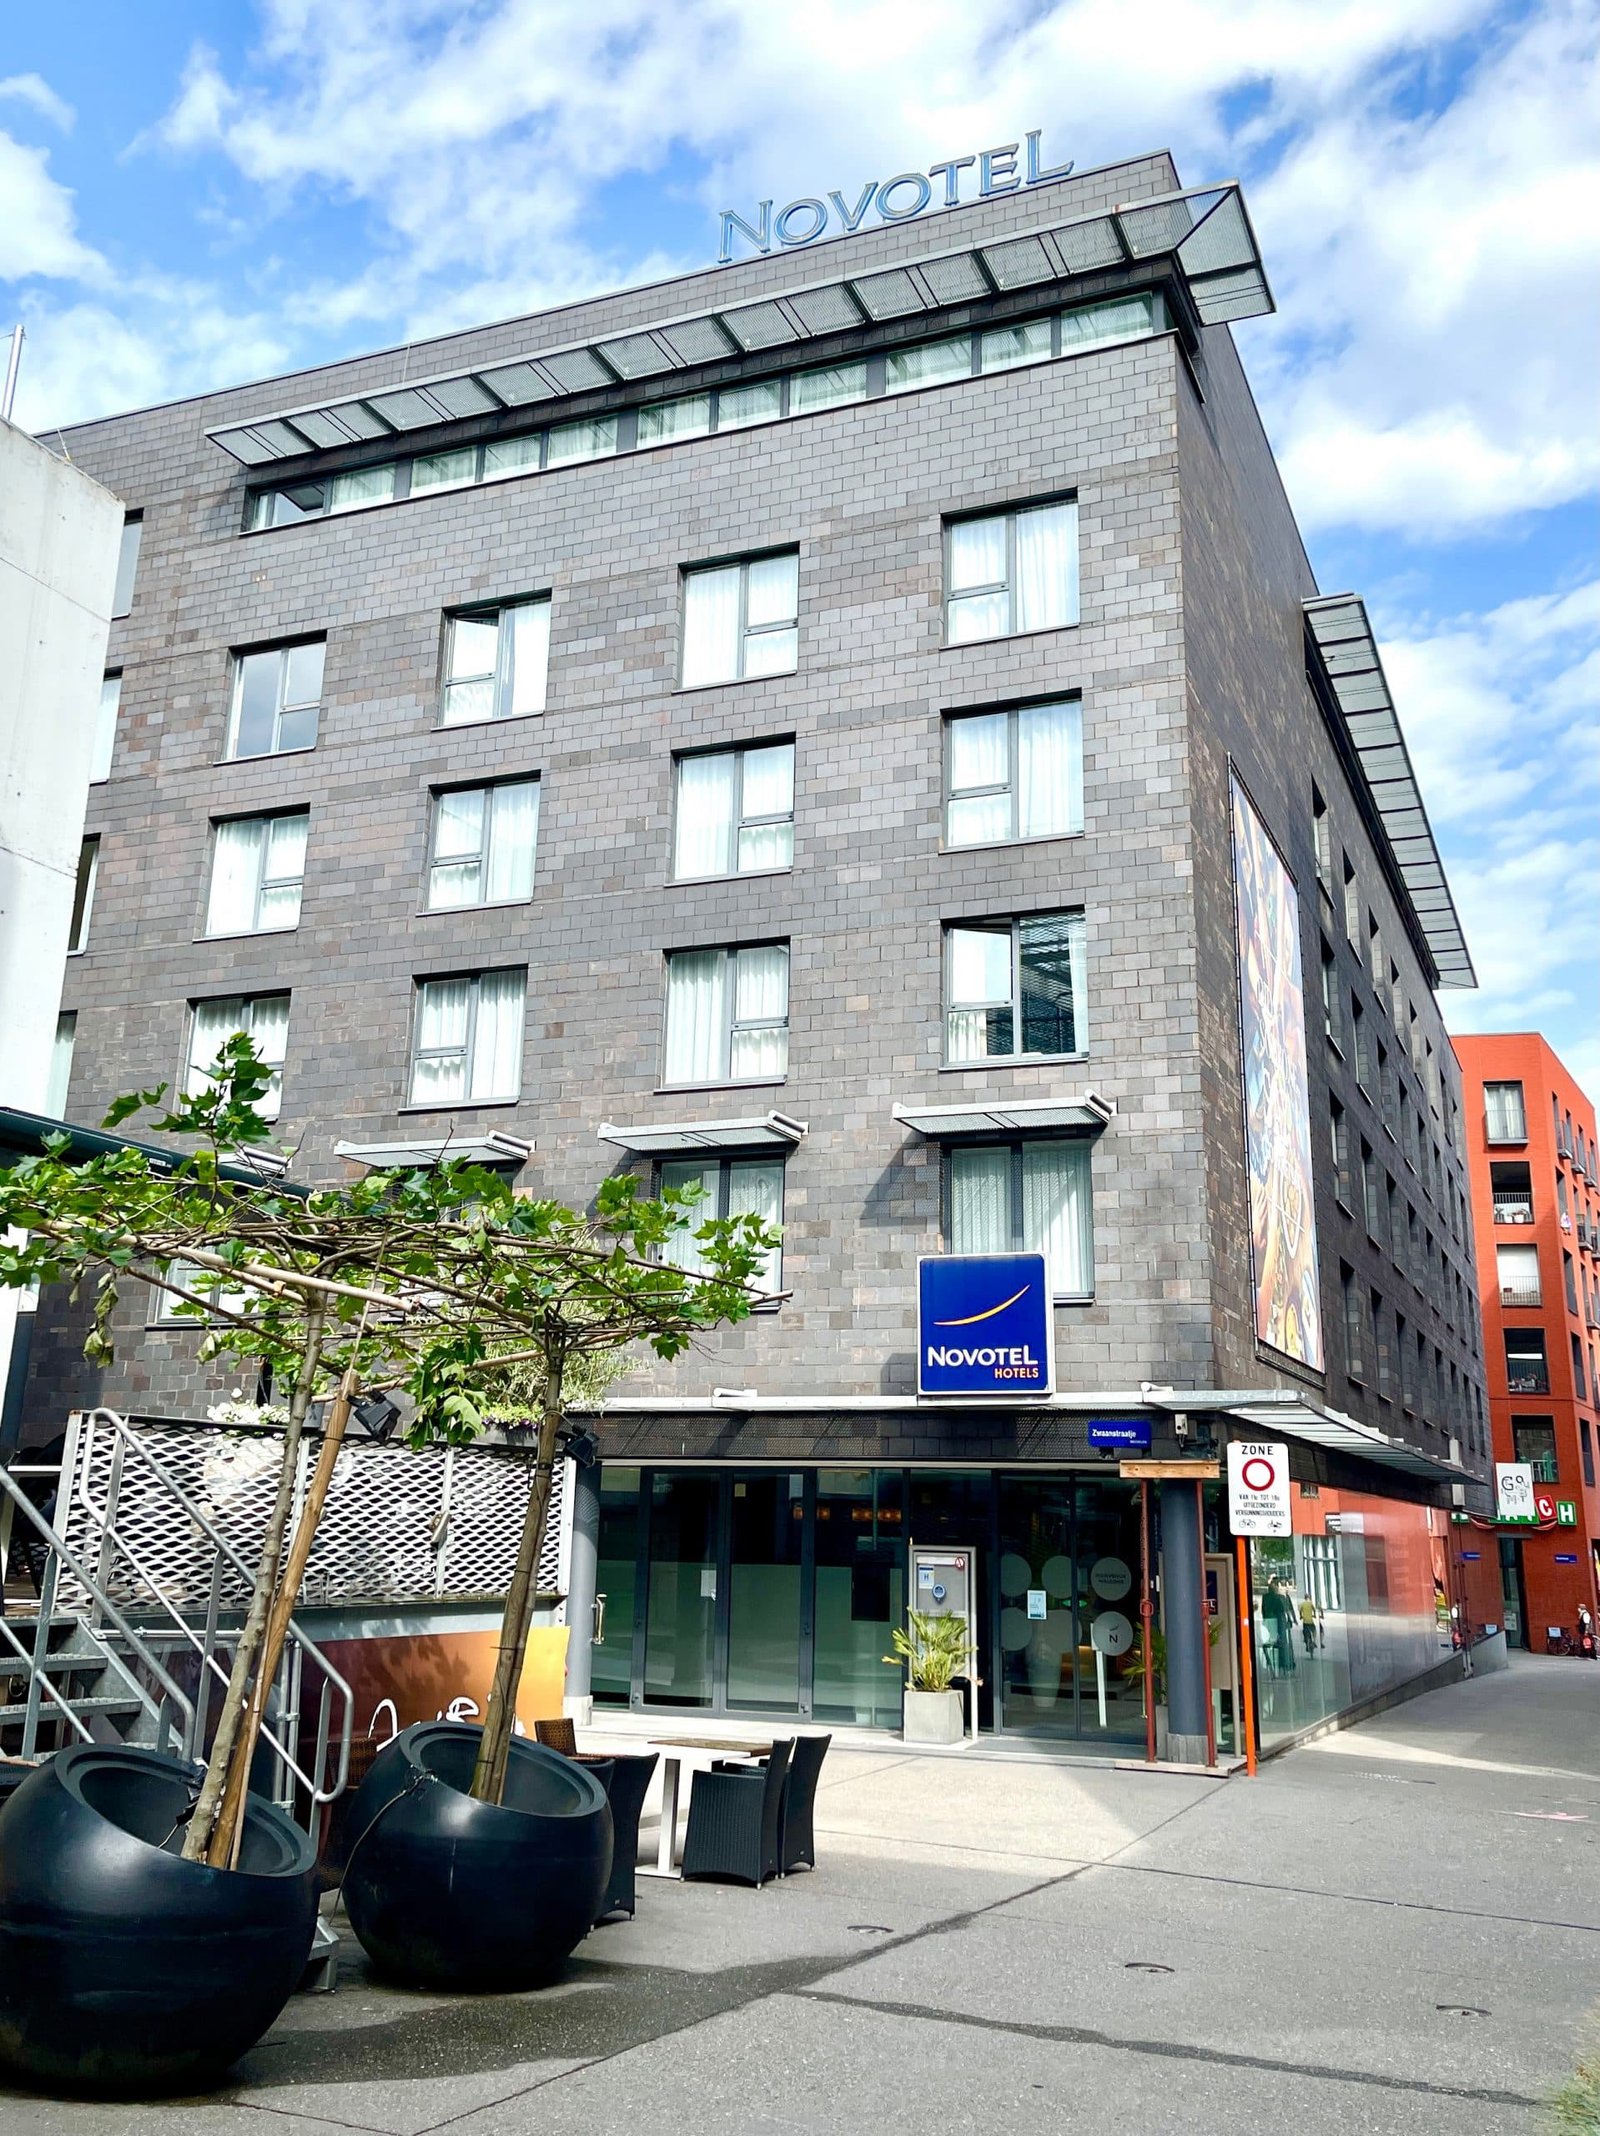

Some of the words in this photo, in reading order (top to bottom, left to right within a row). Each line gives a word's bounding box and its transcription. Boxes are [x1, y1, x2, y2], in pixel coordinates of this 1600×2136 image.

[719, 129, 1074, 263] NOVOTEL
[927, 1344, 1039, 1367] NOVOTEL
[994, 1367, 1039, 1379] HOTELS
[1241, 1444, 1275, 1456] ZONE
